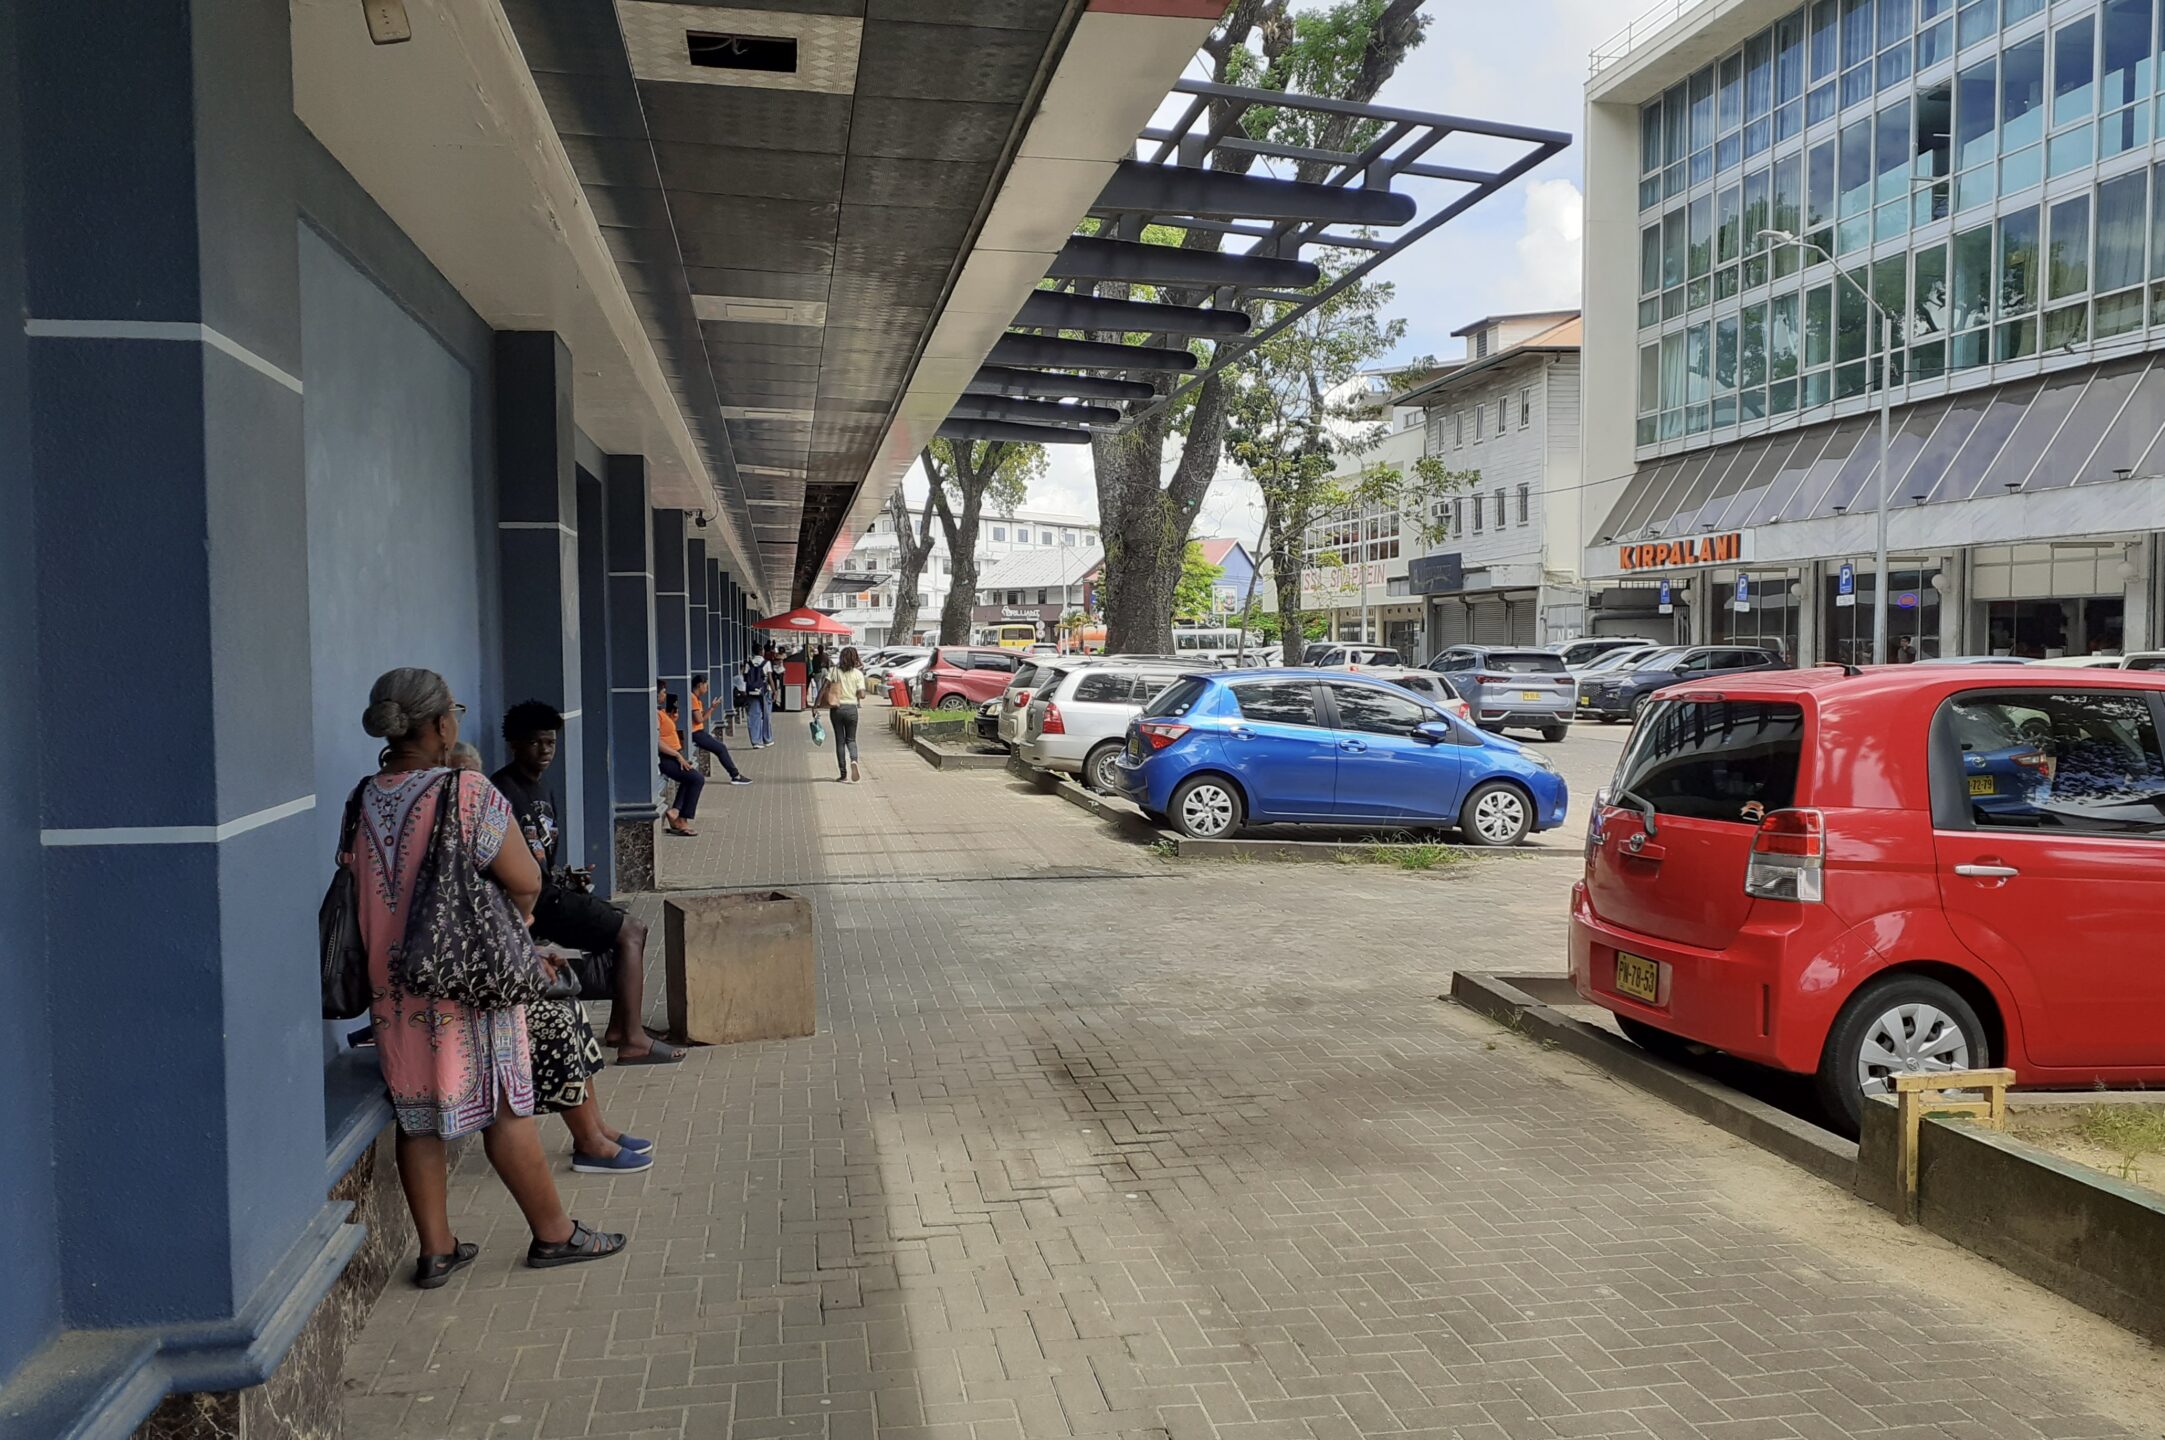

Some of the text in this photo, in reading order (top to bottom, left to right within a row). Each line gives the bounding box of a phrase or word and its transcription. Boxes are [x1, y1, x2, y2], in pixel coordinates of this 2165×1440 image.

[1620, 533, 1741, 570] KIRPALANI
[1842, 568, 1850, 584] P
[1739, 578, 1746, 592] P
[1967, 779, 1992, 790] -72-79
